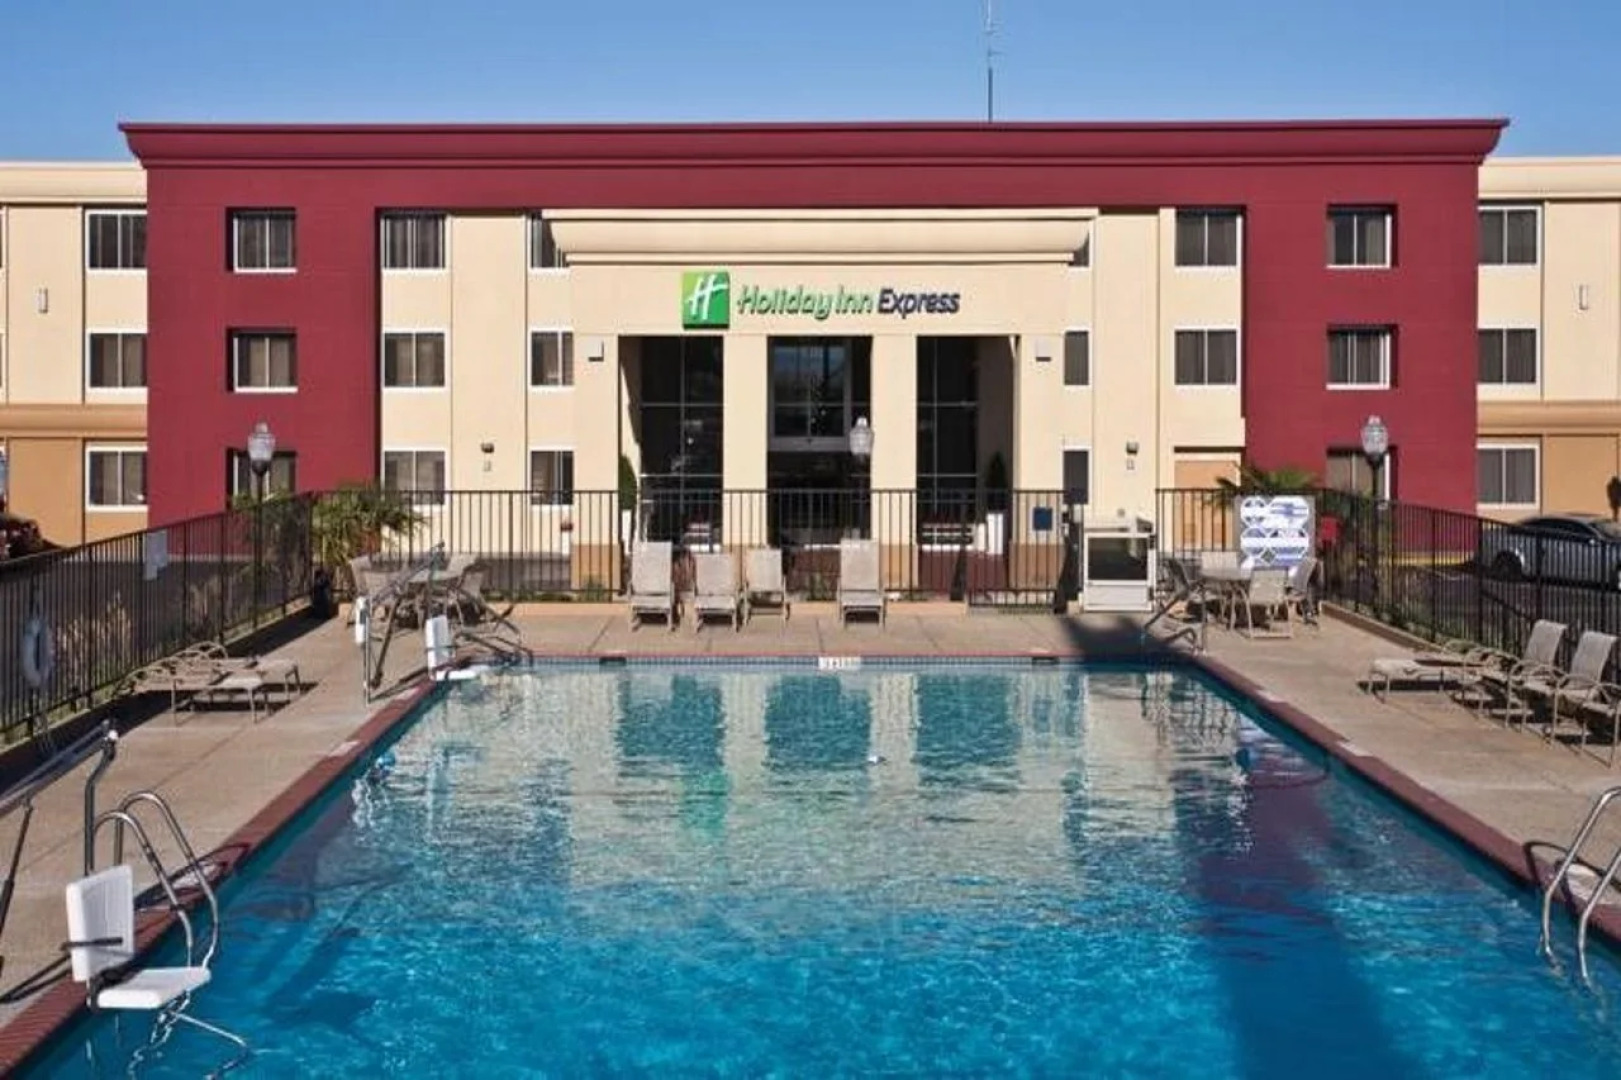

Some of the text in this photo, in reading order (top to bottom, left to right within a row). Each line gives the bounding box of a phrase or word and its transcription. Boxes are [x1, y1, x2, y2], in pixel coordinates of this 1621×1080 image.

[737, 285, 960, 320] Holiday Inn Express
